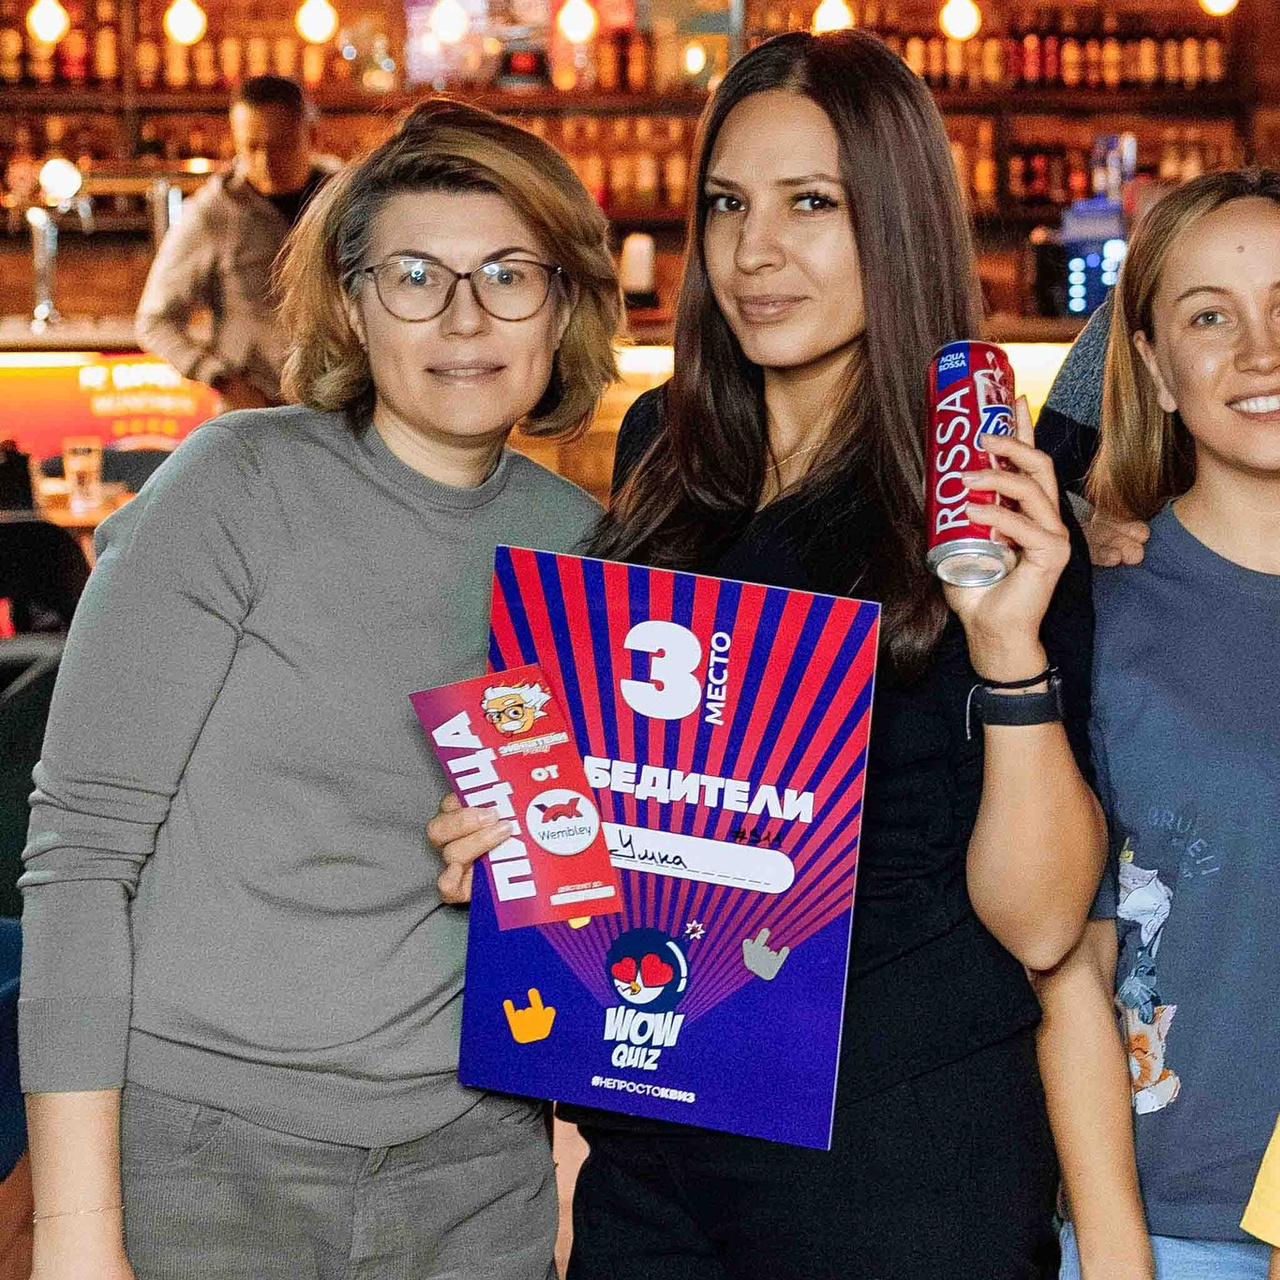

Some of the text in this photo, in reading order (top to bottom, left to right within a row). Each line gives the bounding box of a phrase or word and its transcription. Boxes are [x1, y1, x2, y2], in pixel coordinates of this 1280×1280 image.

[938, 360, 967, 373] ROSSA
[939, 351, 966, 365] AQUA
[936, 386, 970, 535] ROSSA
[620, 620, 732, 726] 3 МЕСТО
[531, 764, 558, 782] ОТ
[583, 755, 815, 824] БЕДИТЕЛИ
[538, 824, 592, 841] Wembley
[610, 829, 687, 869] Умка
[604, 1006, 685, 1047] WOW
[611, 1043, 661, 1070] QUIZ
[591, 1075, 697, 1103] #НЕПРОСТОКВИЗ
